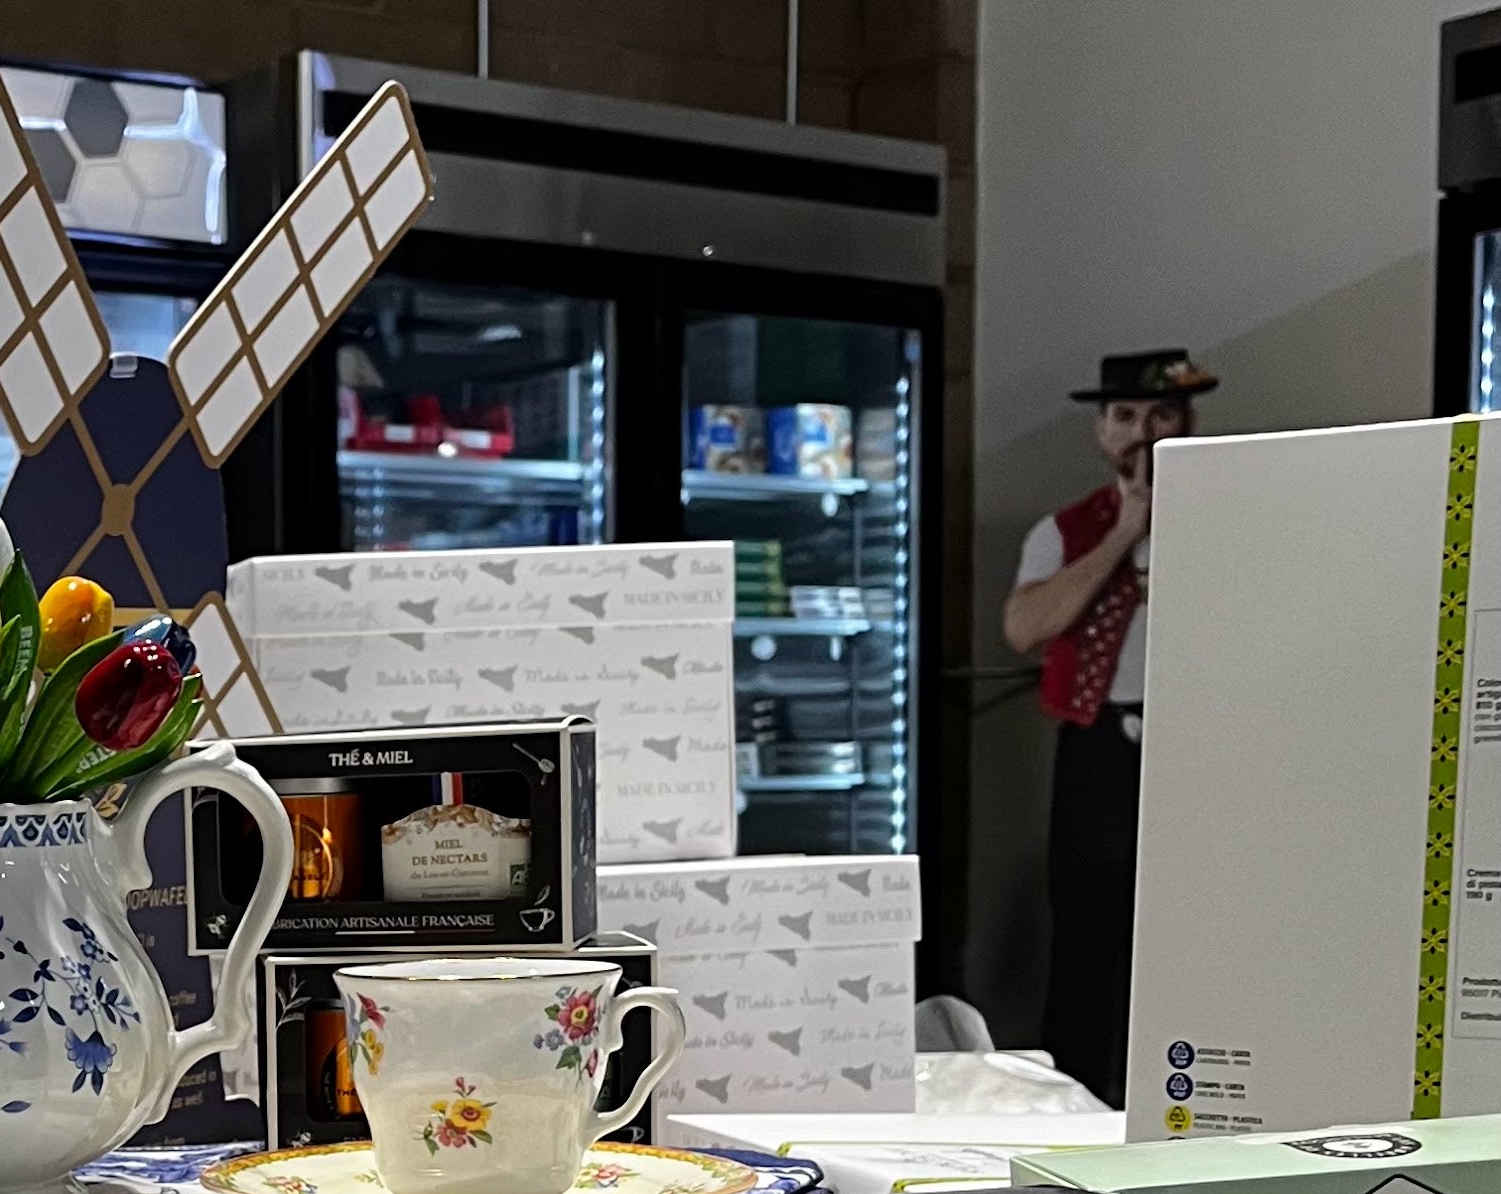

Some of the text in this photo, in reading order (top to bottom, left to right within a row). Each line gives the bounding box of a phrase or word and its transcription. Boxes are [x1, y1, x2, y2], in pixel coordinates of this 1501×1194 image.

[329, 749, 413, 767] THÉ & MIEL
[435, 839, 462, 850] MIEL
[412, 853, 488, 866] DE NECTARS
[127, 885, 188, 910] OPWAFE
[274, 914, 495, 931] BRICATION ARTISANALE FRANÇAISE
